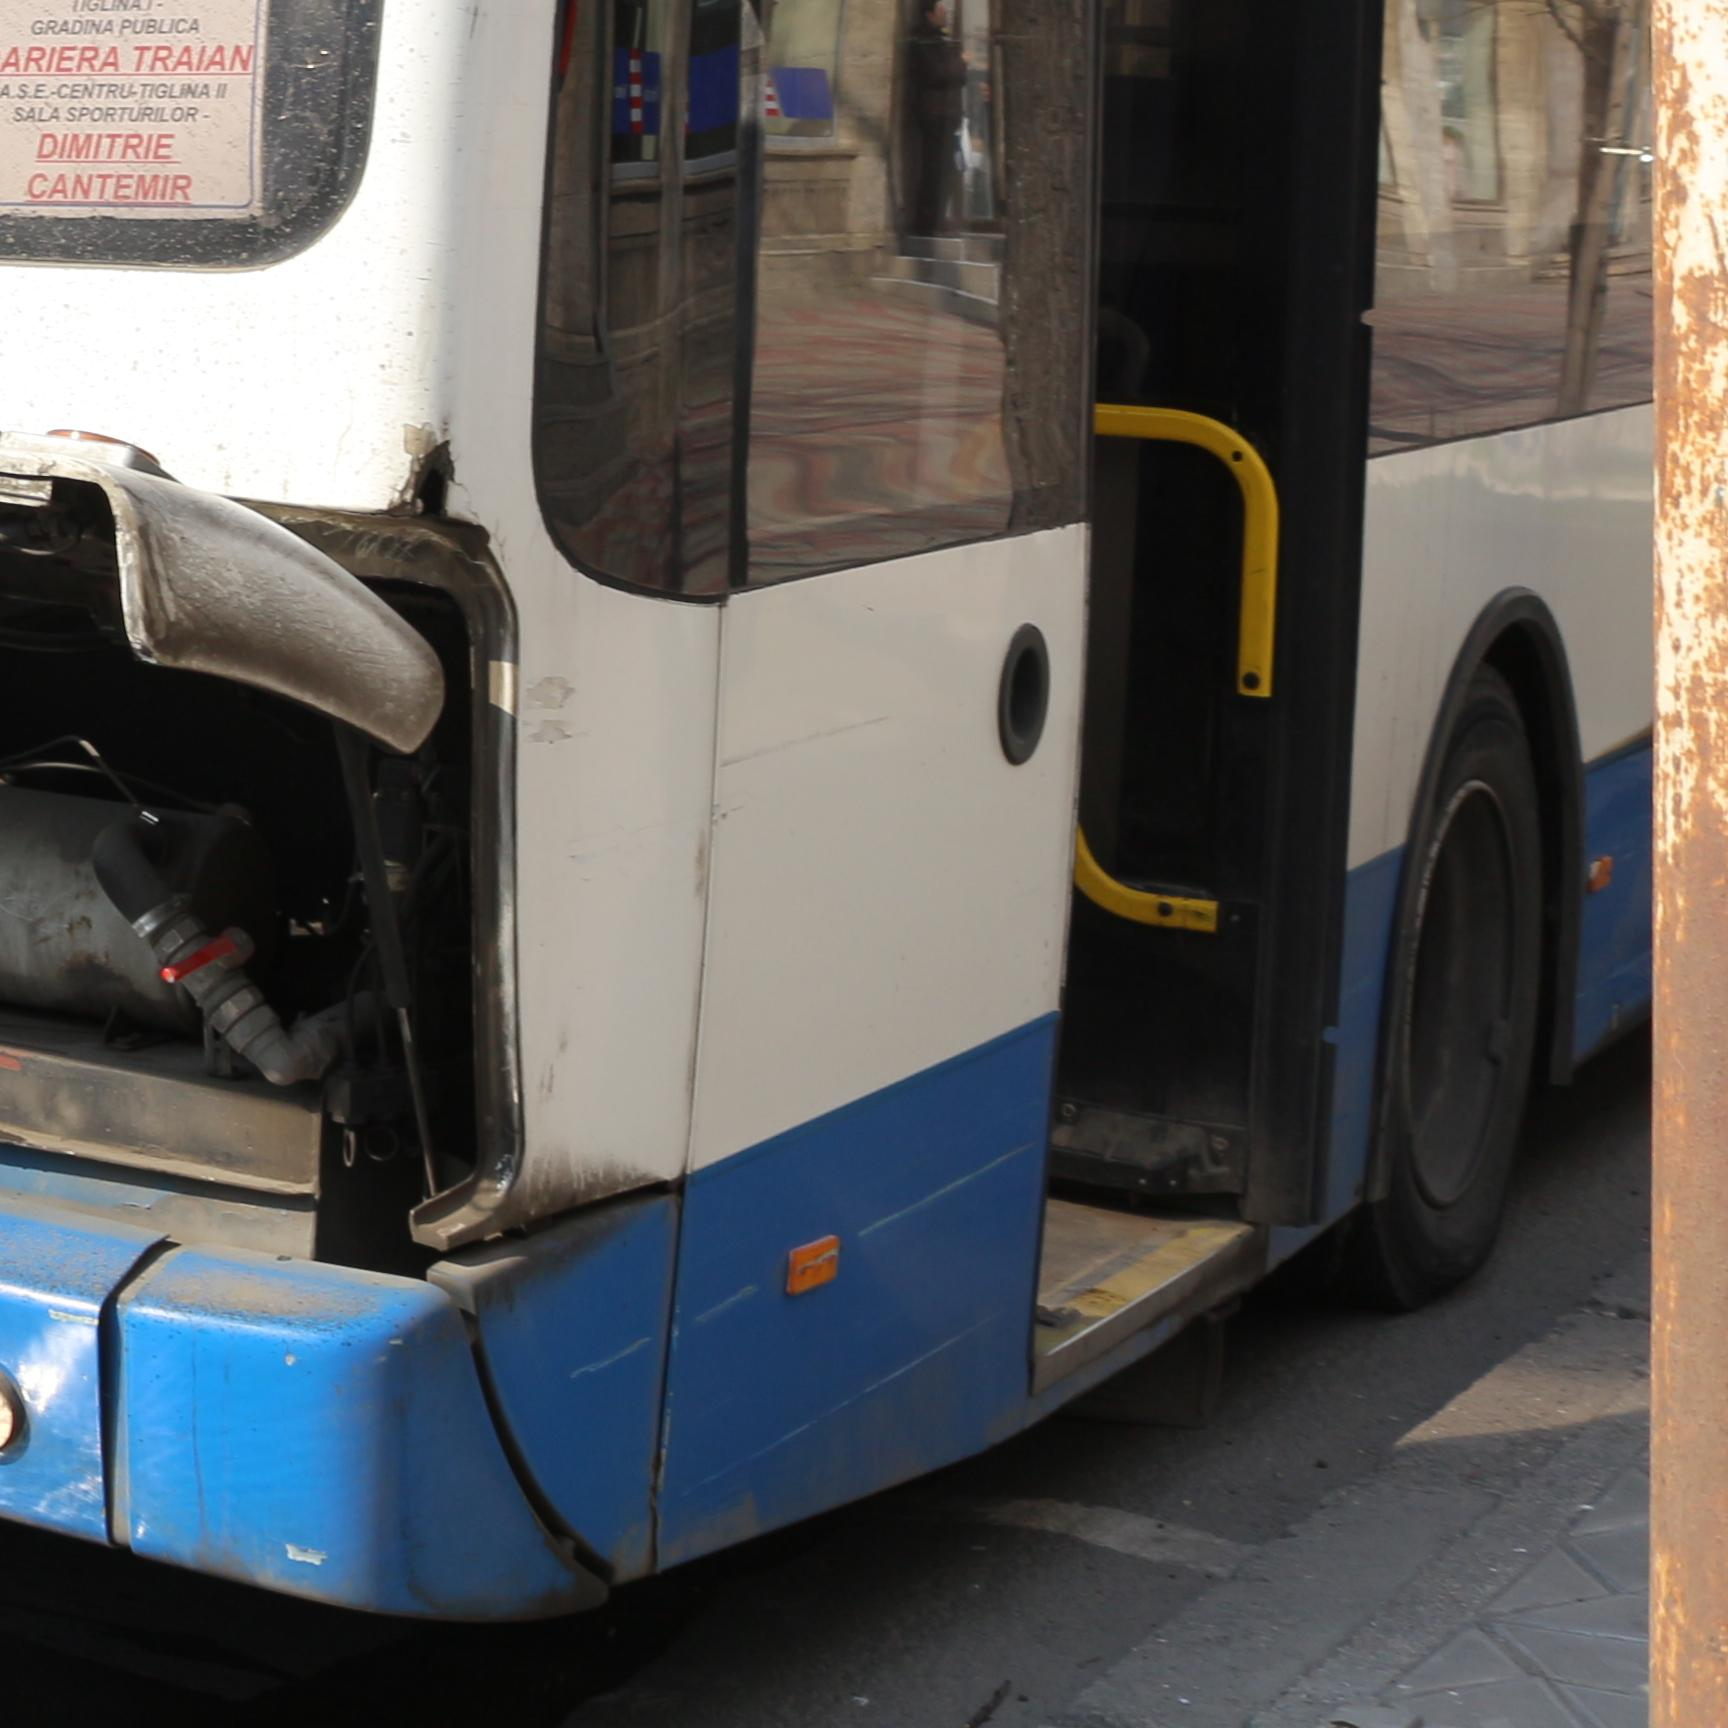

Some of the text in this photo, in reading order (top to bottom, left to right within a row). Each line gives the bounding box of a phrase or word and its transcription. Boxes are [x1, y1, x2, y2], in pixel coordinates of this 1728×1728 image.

[30, 18, 201, 36] GRADINA PUBLICA
[132, 45, 255, 73] TRAIAN
[12, 107, 60, 123] SALA
[65, 106, 200, 122] SPORTURILOR
[36, 133, 176, 160] DIMITRIE
[26, 173, 193, 202] CANTEMIR
